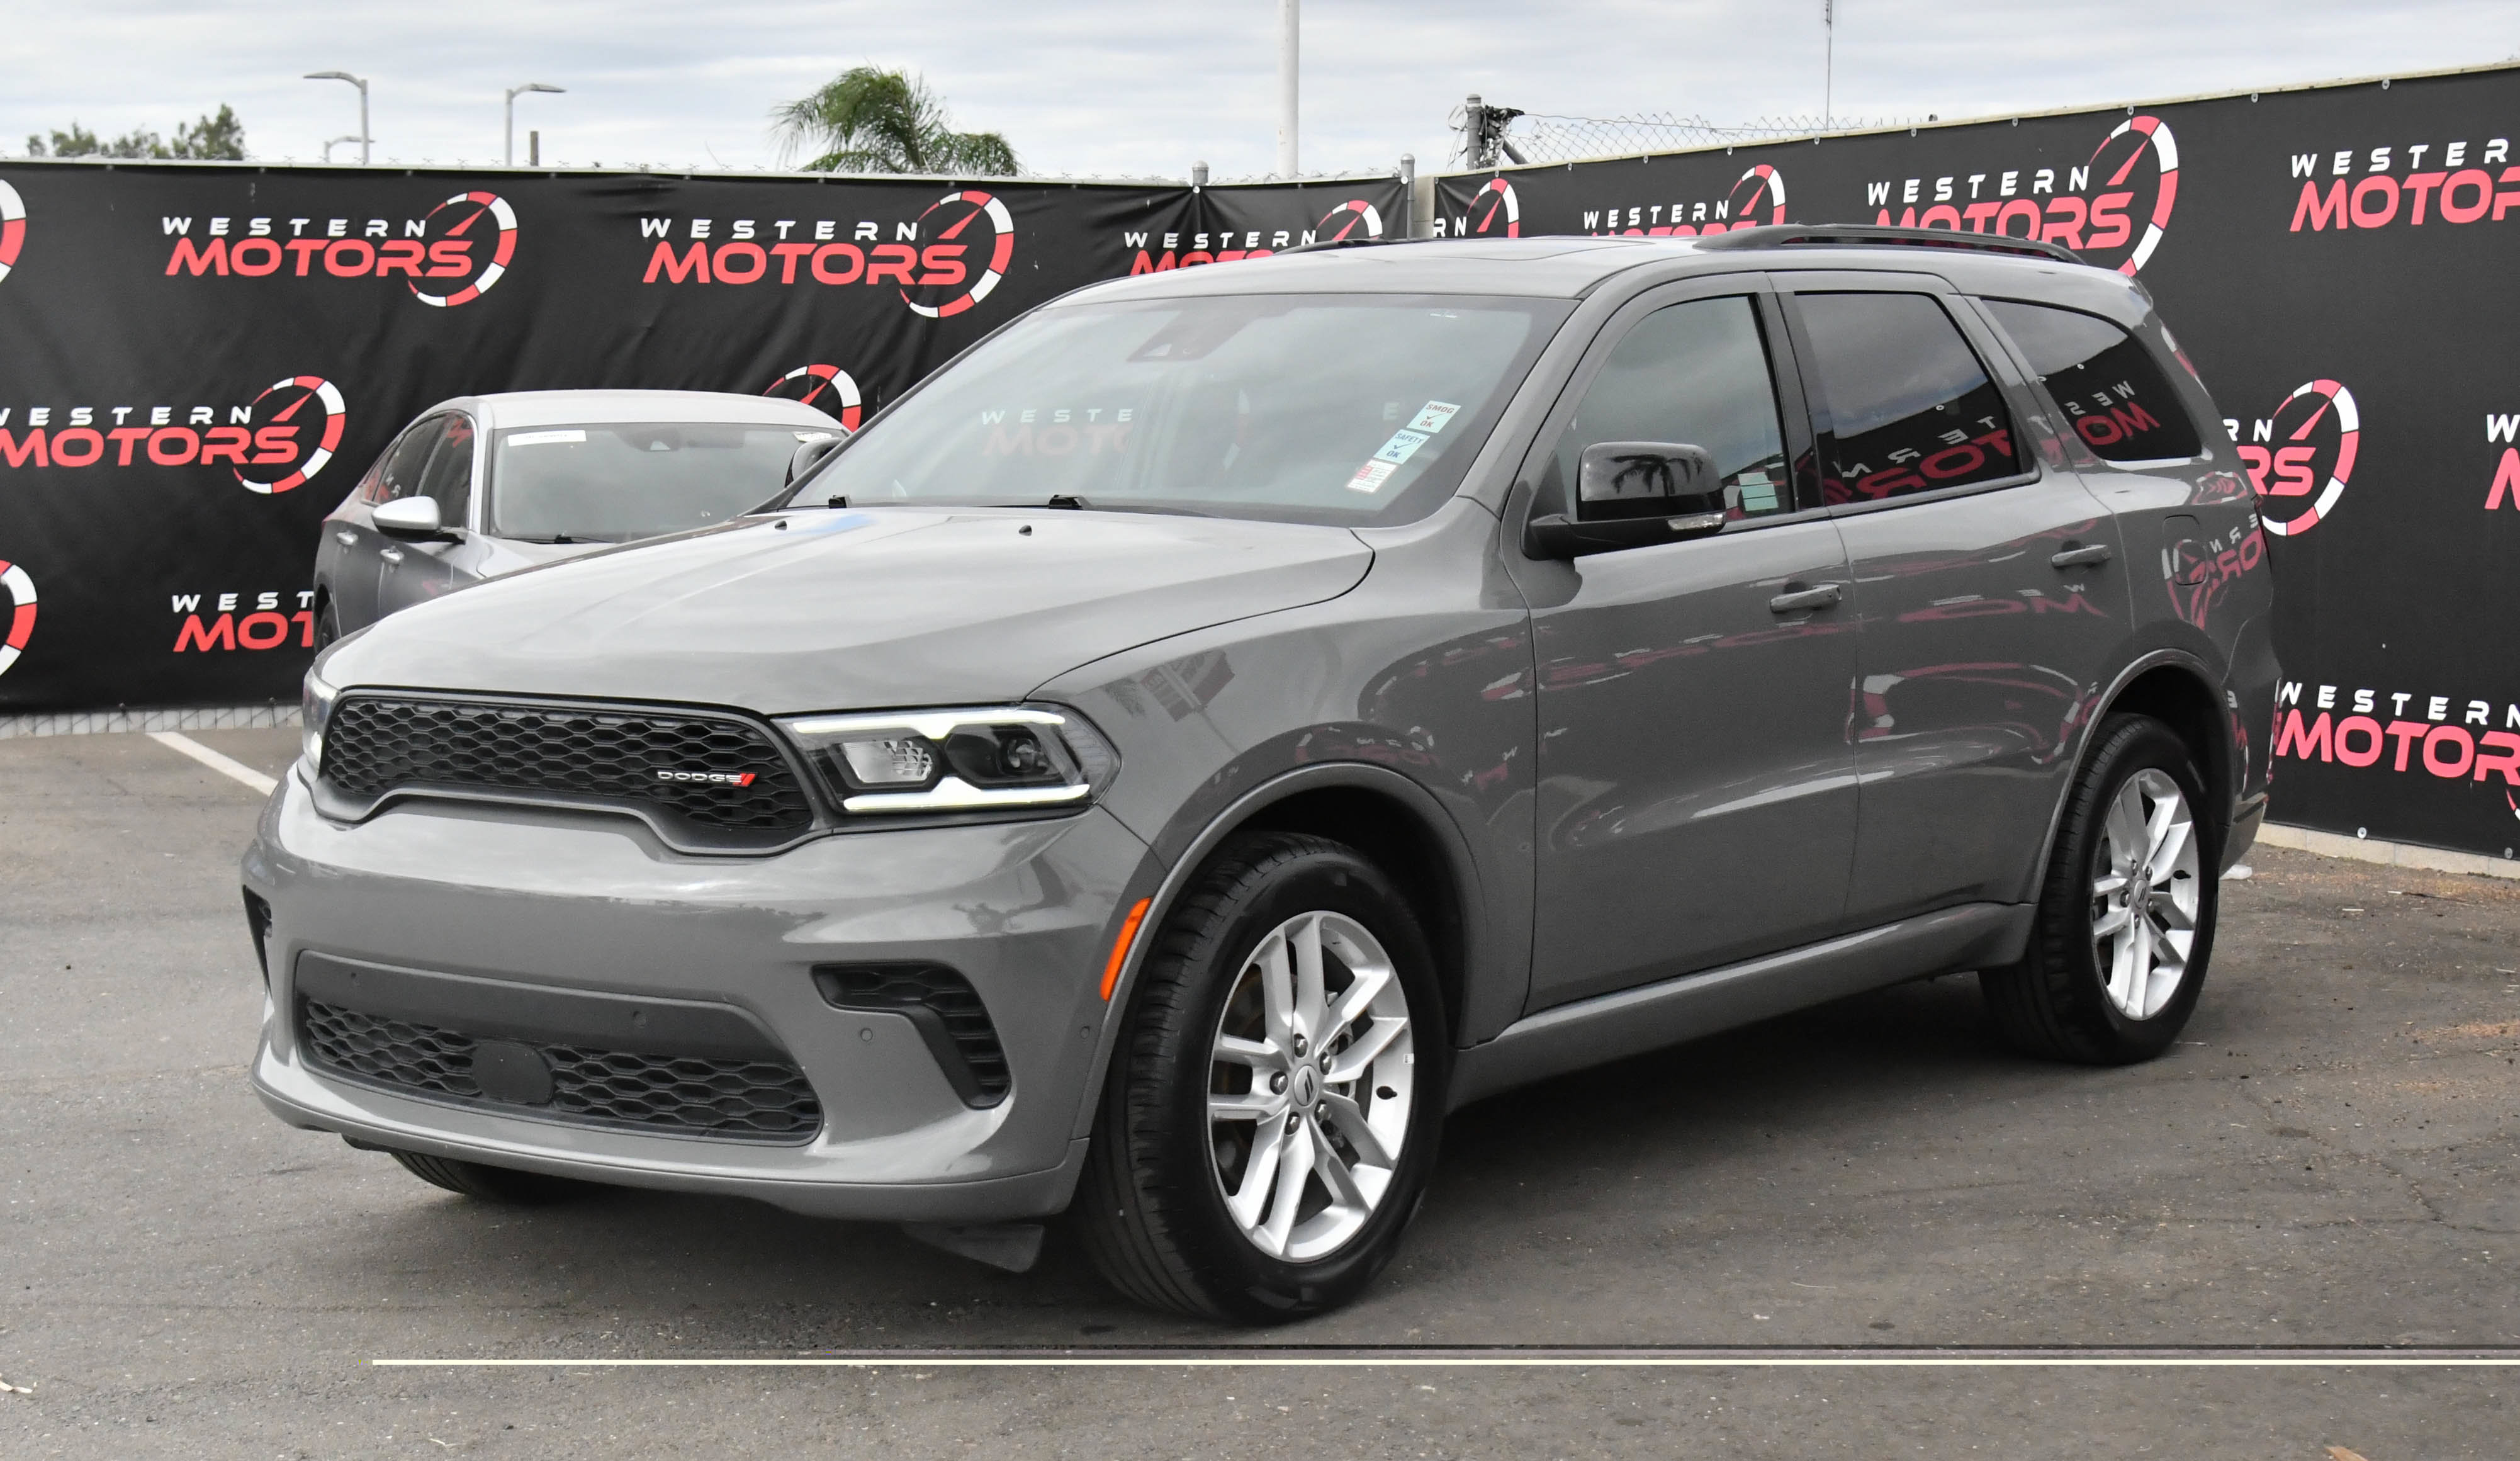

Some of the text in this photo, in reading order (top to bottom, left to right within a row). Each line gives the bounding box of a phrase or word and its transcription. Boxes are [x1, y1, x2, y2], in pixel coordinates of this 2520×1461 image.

[1867, 166, 2090, 206] WESTERN
[1583, 200, 1729, 230] WESTERN
[162, 217, 426, 237] WESTERN
[641, 218, 918, 241] WESTERN
[1124, 230, 1316, 249] WESTERN
[166, 237, 473, 277] MOTORS
[643, 241, 967, 285] MOTORS
[1426, 403, 1454, 414] SMOG
[0, 427, 300, 468] MOTORS
[1395, 432, 1424, 444] SAFETY
[1387, 450, 1400, 458] OK
[658, 771, 741, 782] DODGE
